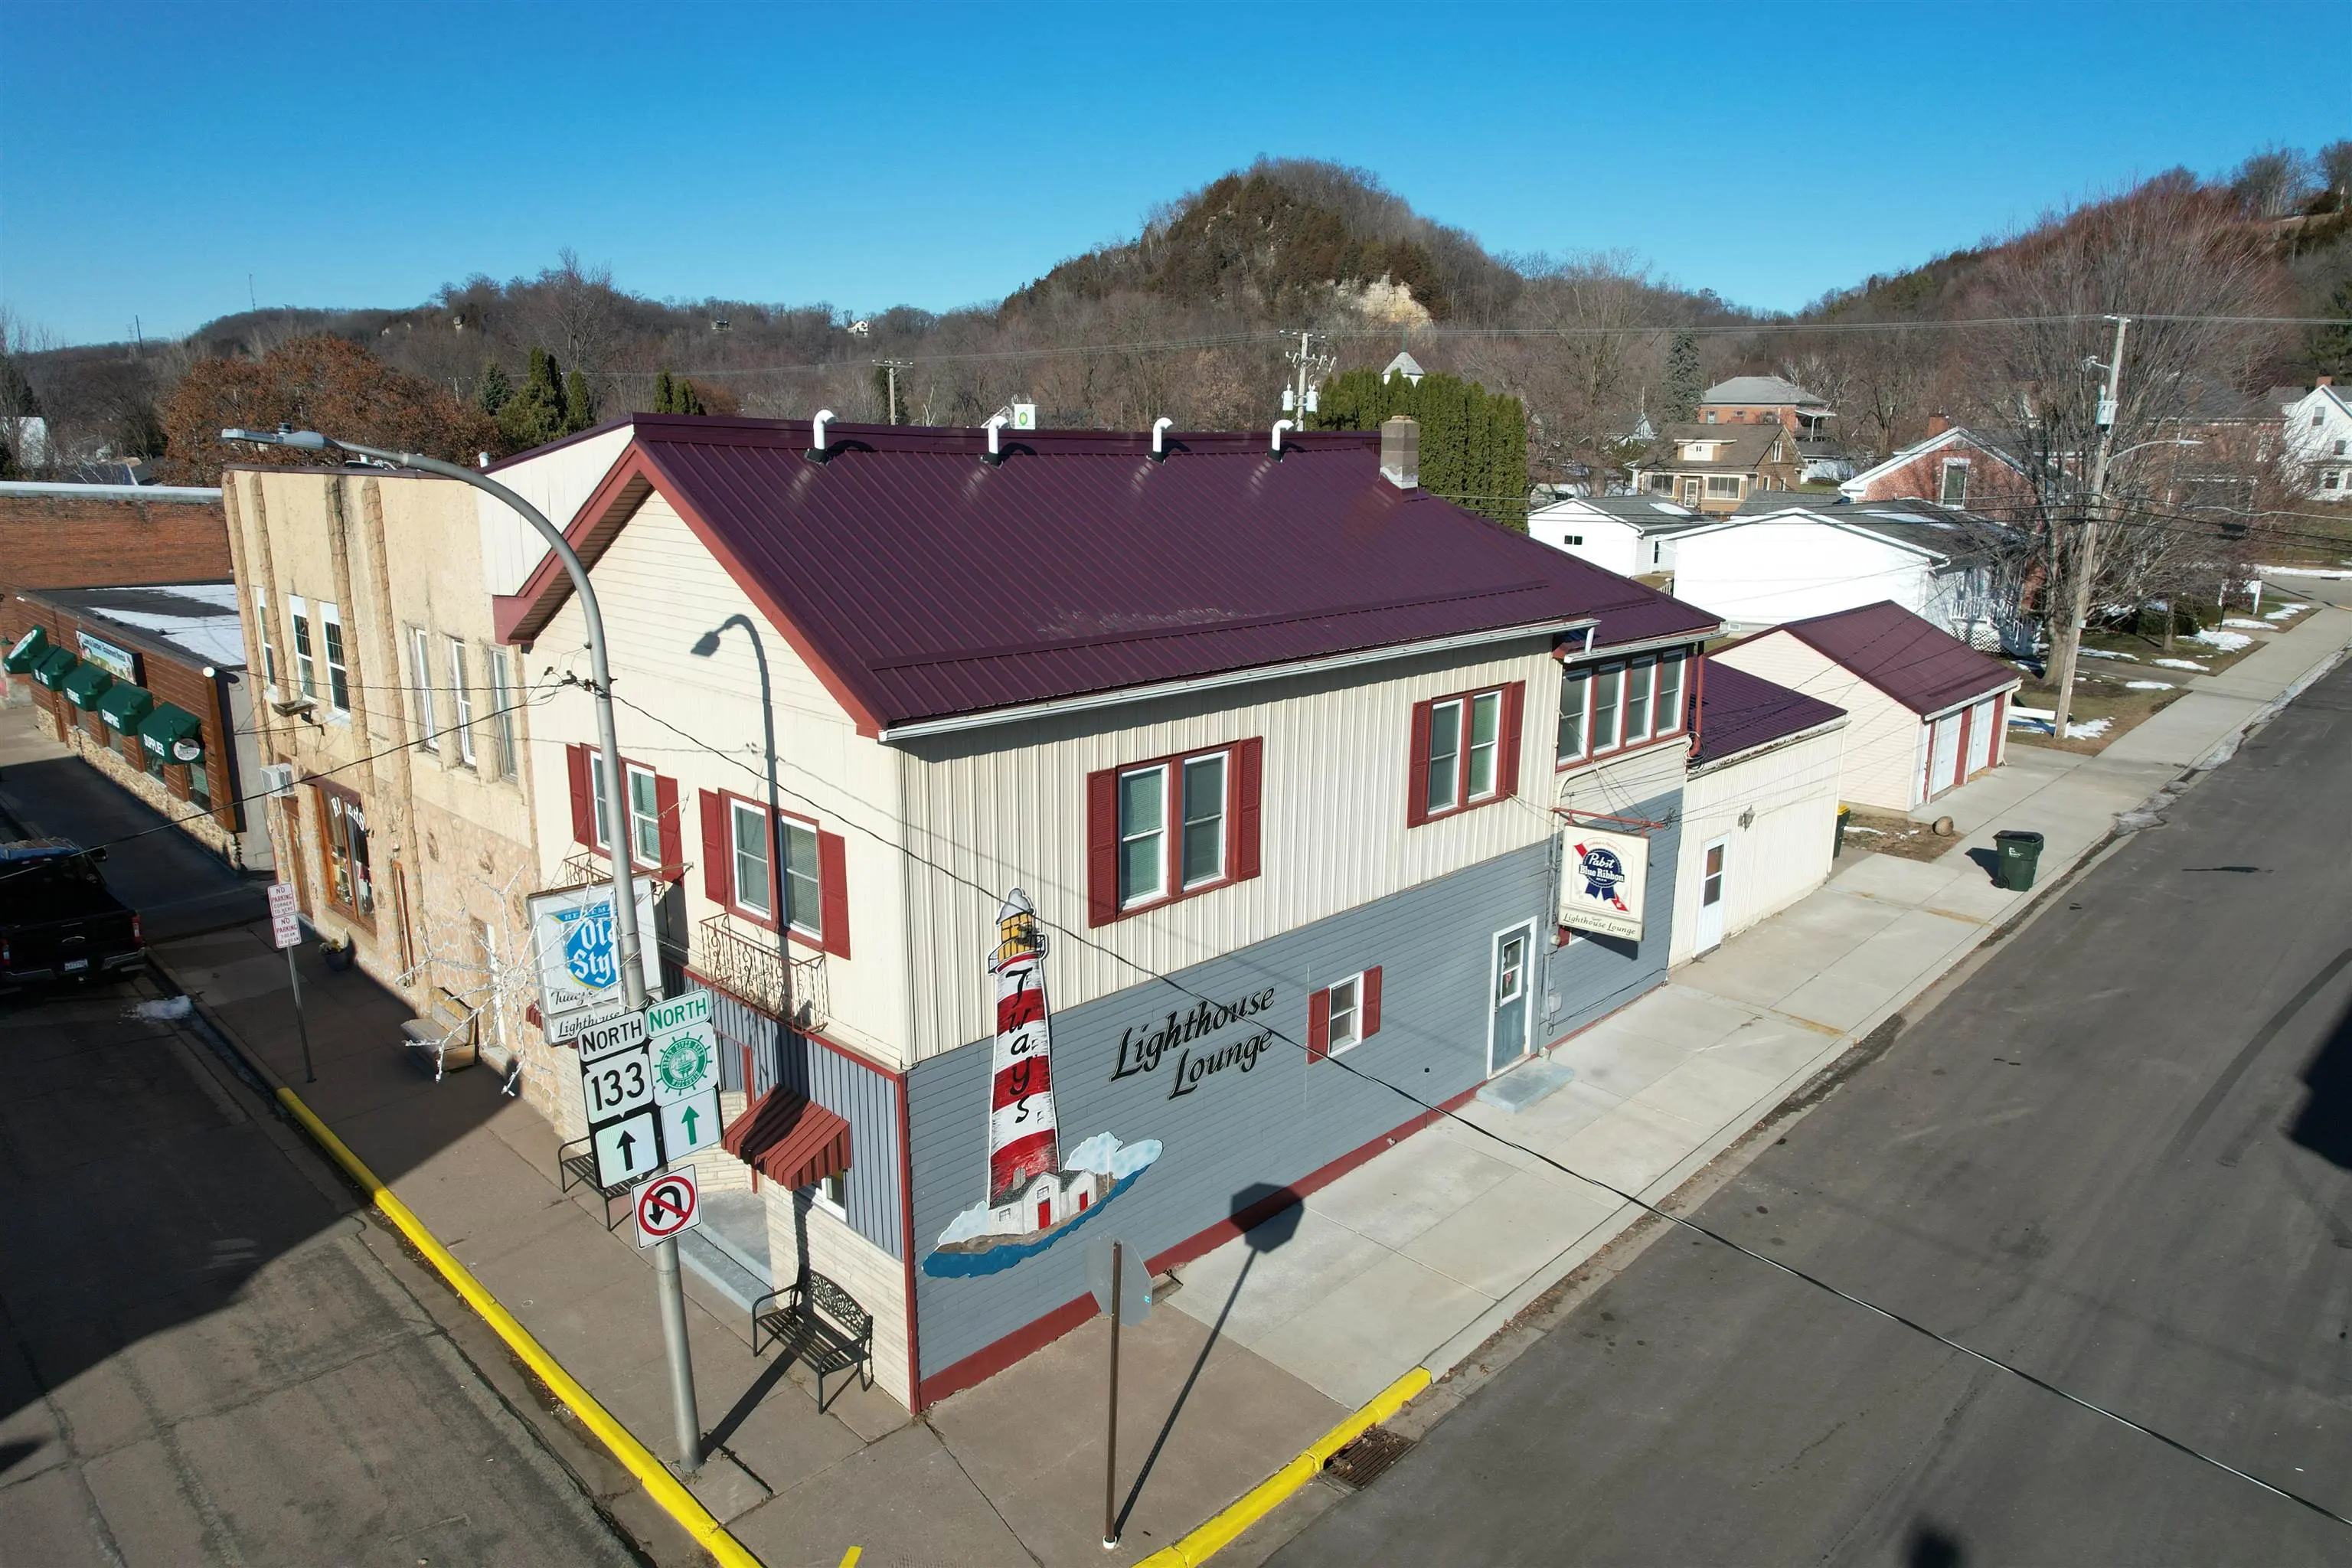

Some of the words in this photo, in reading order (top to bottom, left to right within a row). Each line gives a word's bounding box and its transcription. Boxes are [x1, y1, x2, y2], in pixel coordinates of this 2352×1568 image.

[1588, 852, 1615, 868] Pabst
[1579, 864, 1596, 877] Blue
[1597, 868, 1624, 881] Ribbon
[270, 894, 292, 903] PARKING
[276, 924, 297, 933] PARKING
[1563, 913, 1606, 928] Lighthouse
[1607, 922, 1635, 936] Lounge
[649, 998, 707, 1032] NORTH
[582, 1018, 642, 1055] NORTH
[674, 1040, 692, 1050] RIVER
[1109, 985, 1275, 1083] Lighthouse
[1166, 1030, 1274, 1100] Lounge
[591, 1062, 645, 1111] 133
